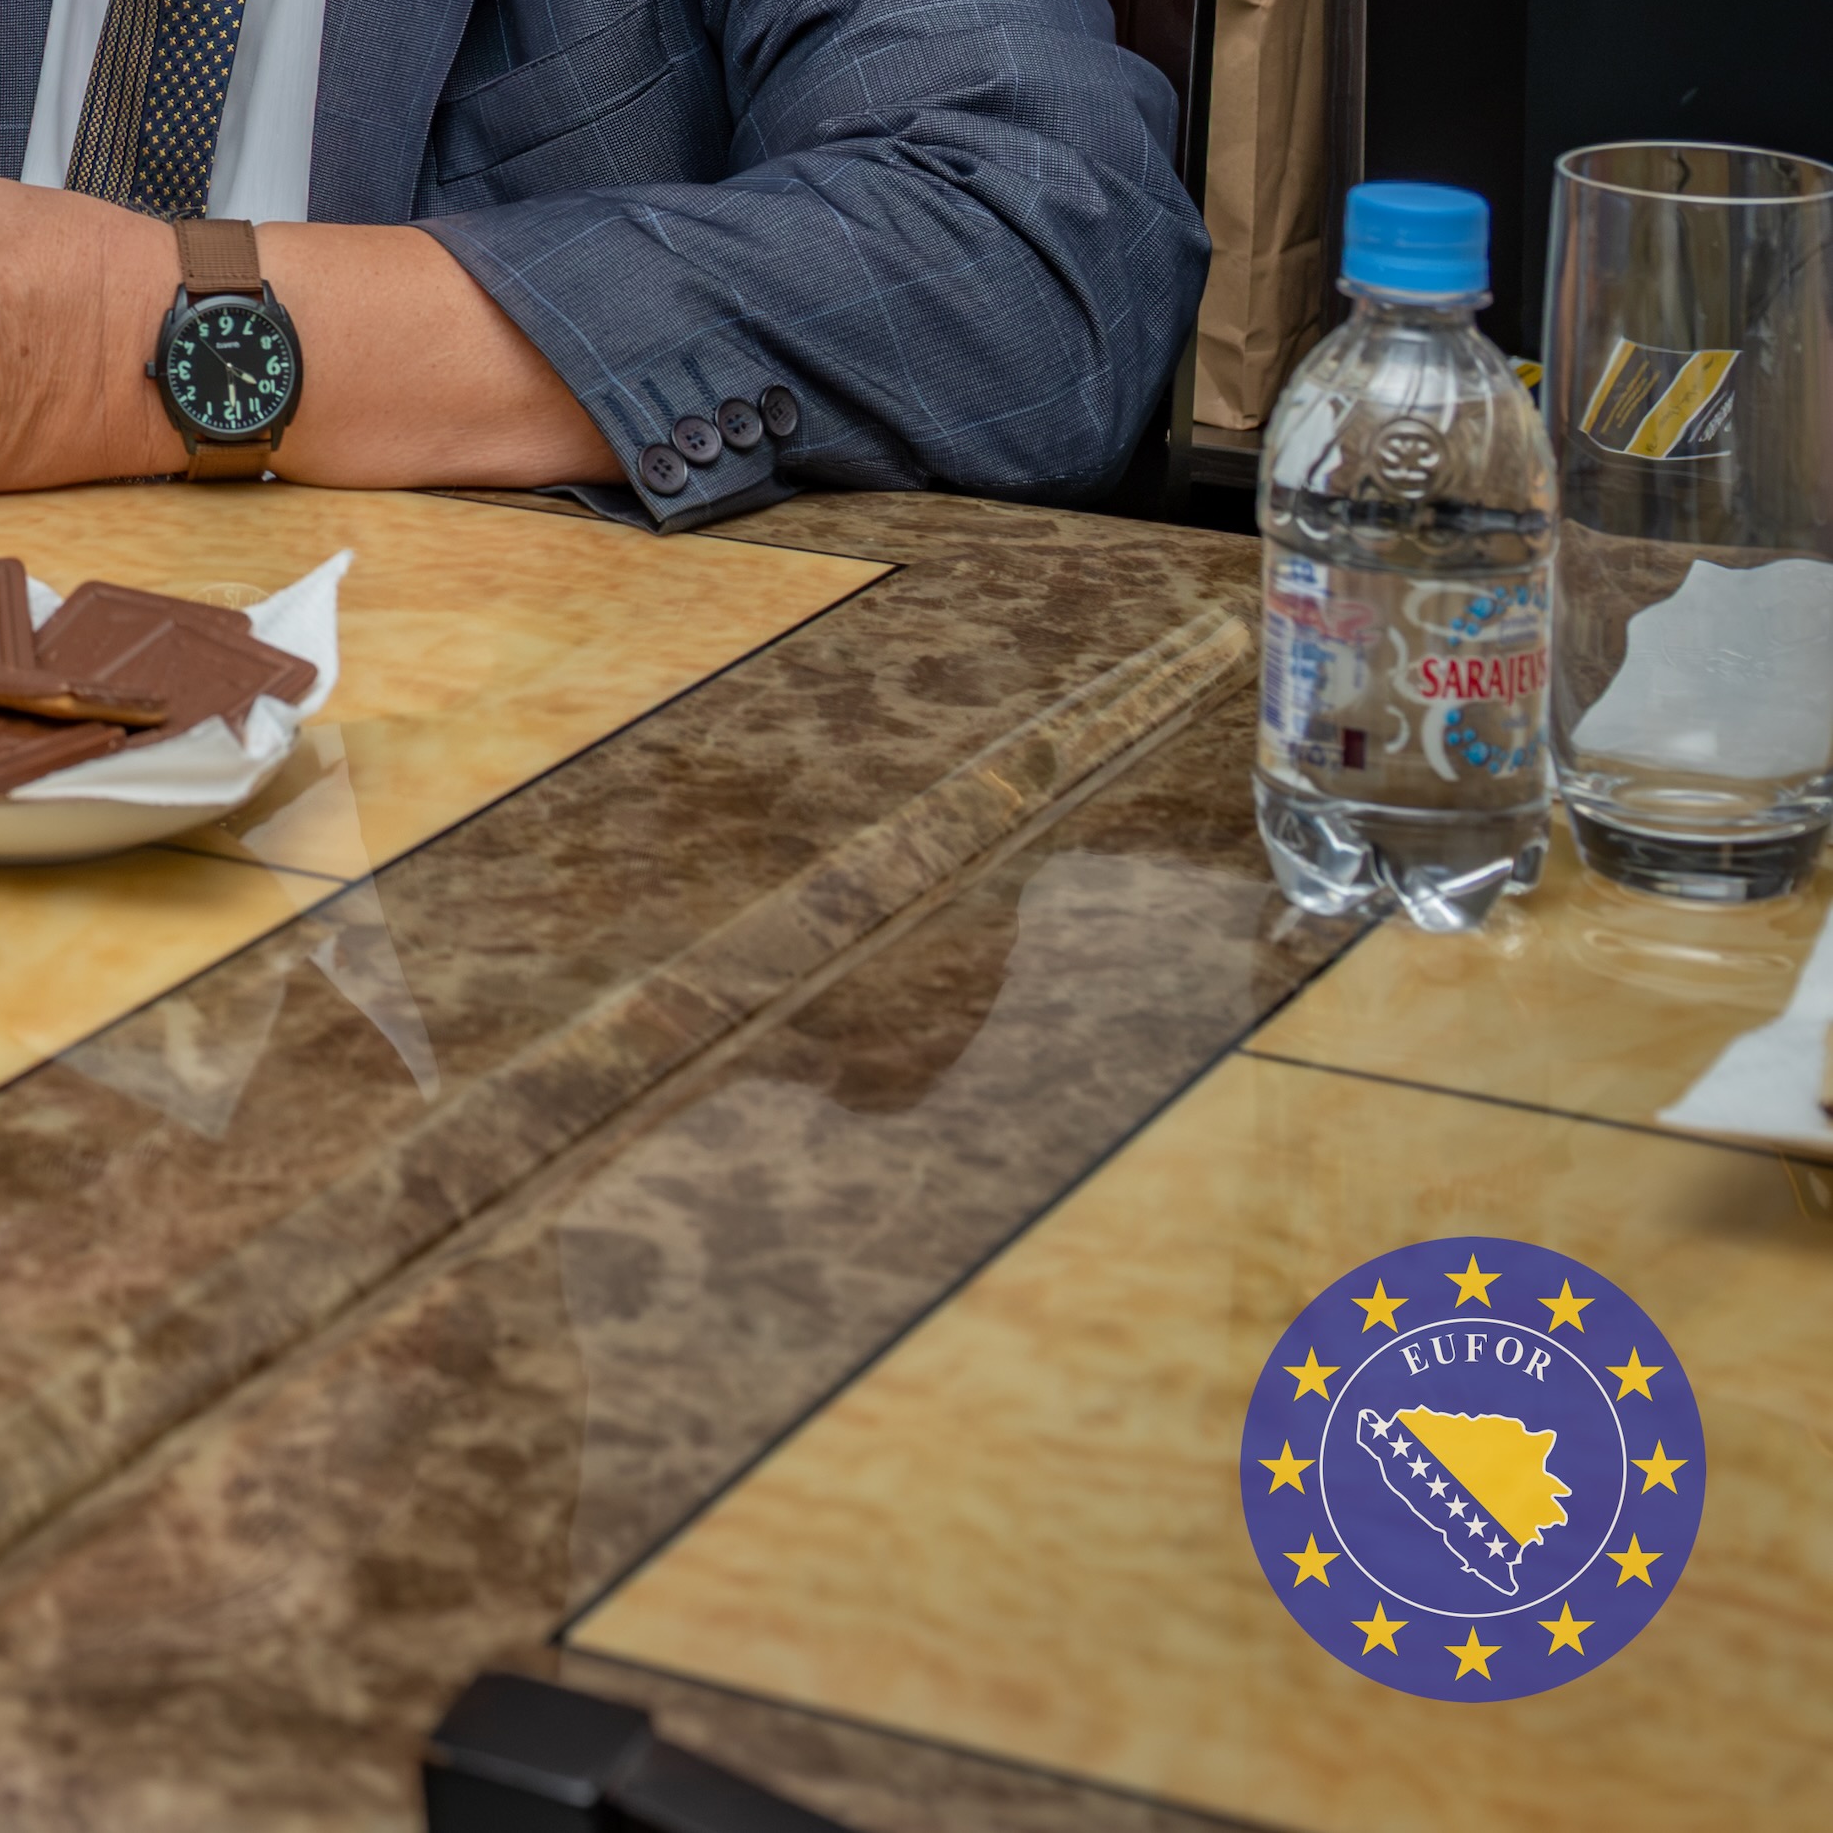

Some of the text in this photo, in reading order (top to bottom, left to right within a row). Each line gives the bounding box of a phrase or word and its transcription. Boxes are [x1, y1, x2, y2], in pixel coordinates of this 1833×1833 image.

[199, 323, 209, 337] 5
[242, 321, 253, 335] 7
[184, 341, 195, 355] 4
[260, 335, 272, 350] 8
[178, 360, 192, 380] 3
[187, 386, 196, 401] 2
[258, 379, 276, 394] 10
[206, 401, 212, 416] 1
[223, 400, 241, 420] 12
[249, 397, 261, 412] 11
